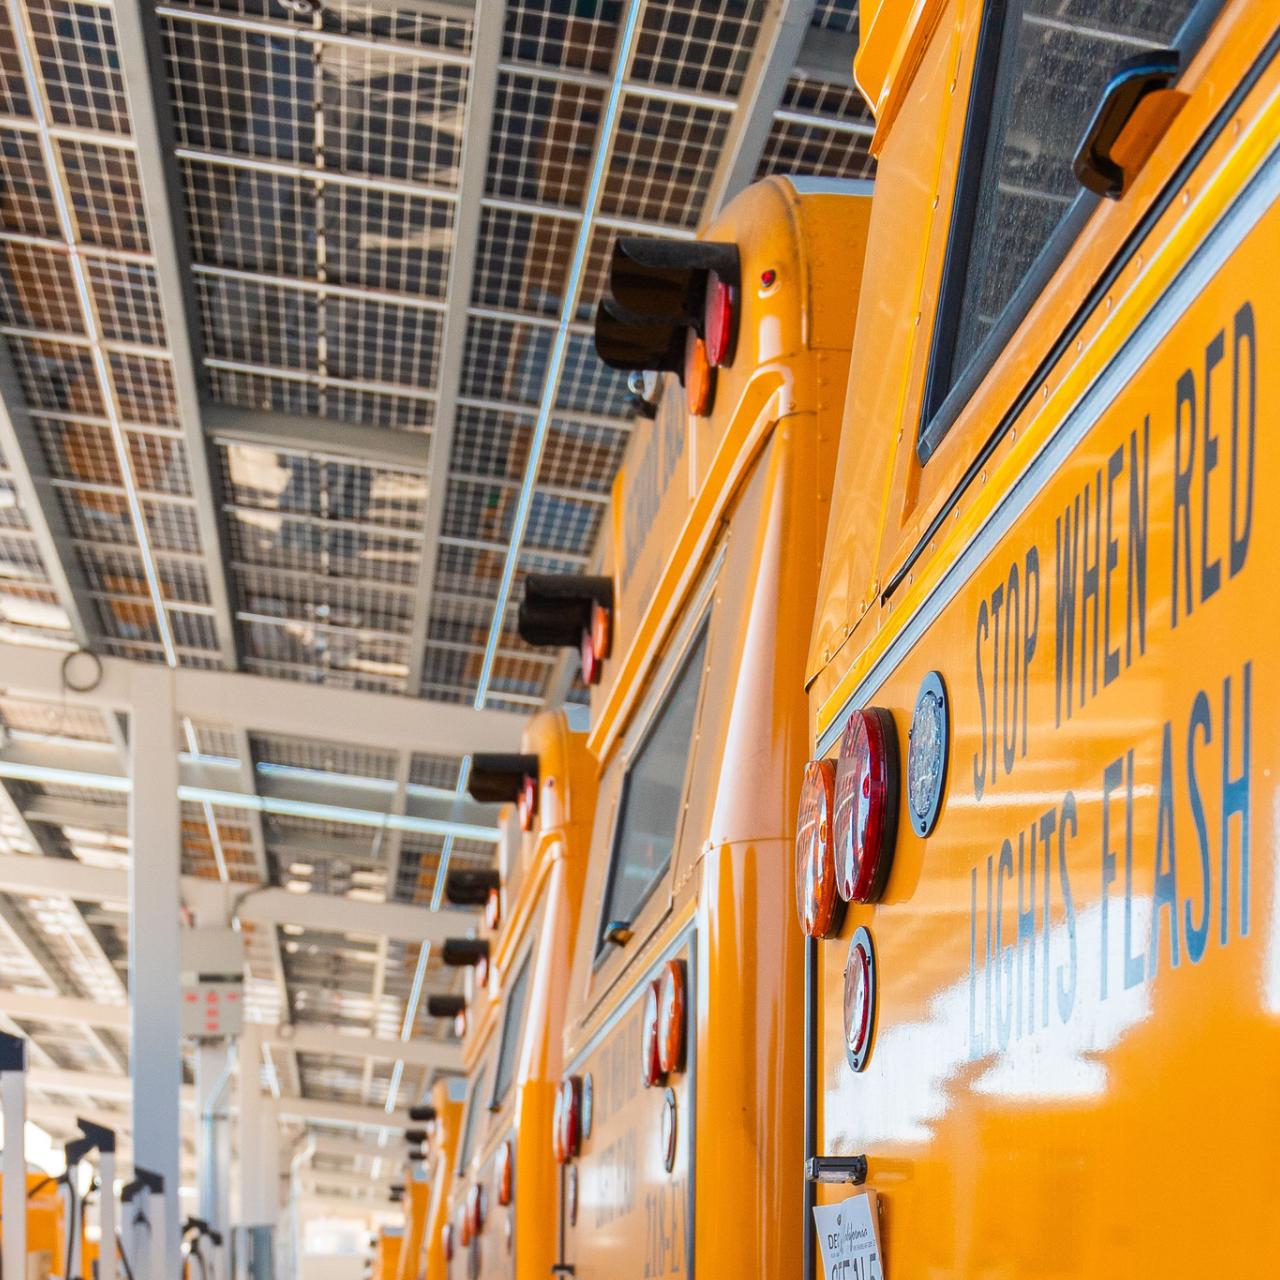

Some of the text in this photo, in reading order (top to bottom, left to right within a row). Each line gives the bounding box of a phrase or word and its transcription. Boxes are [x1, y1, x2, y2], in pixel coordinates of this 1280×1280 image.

[973, 301, 1258, 801] STOP WHEN RED
[967, 661, 1254, 1063] LIGHTS FLASH
